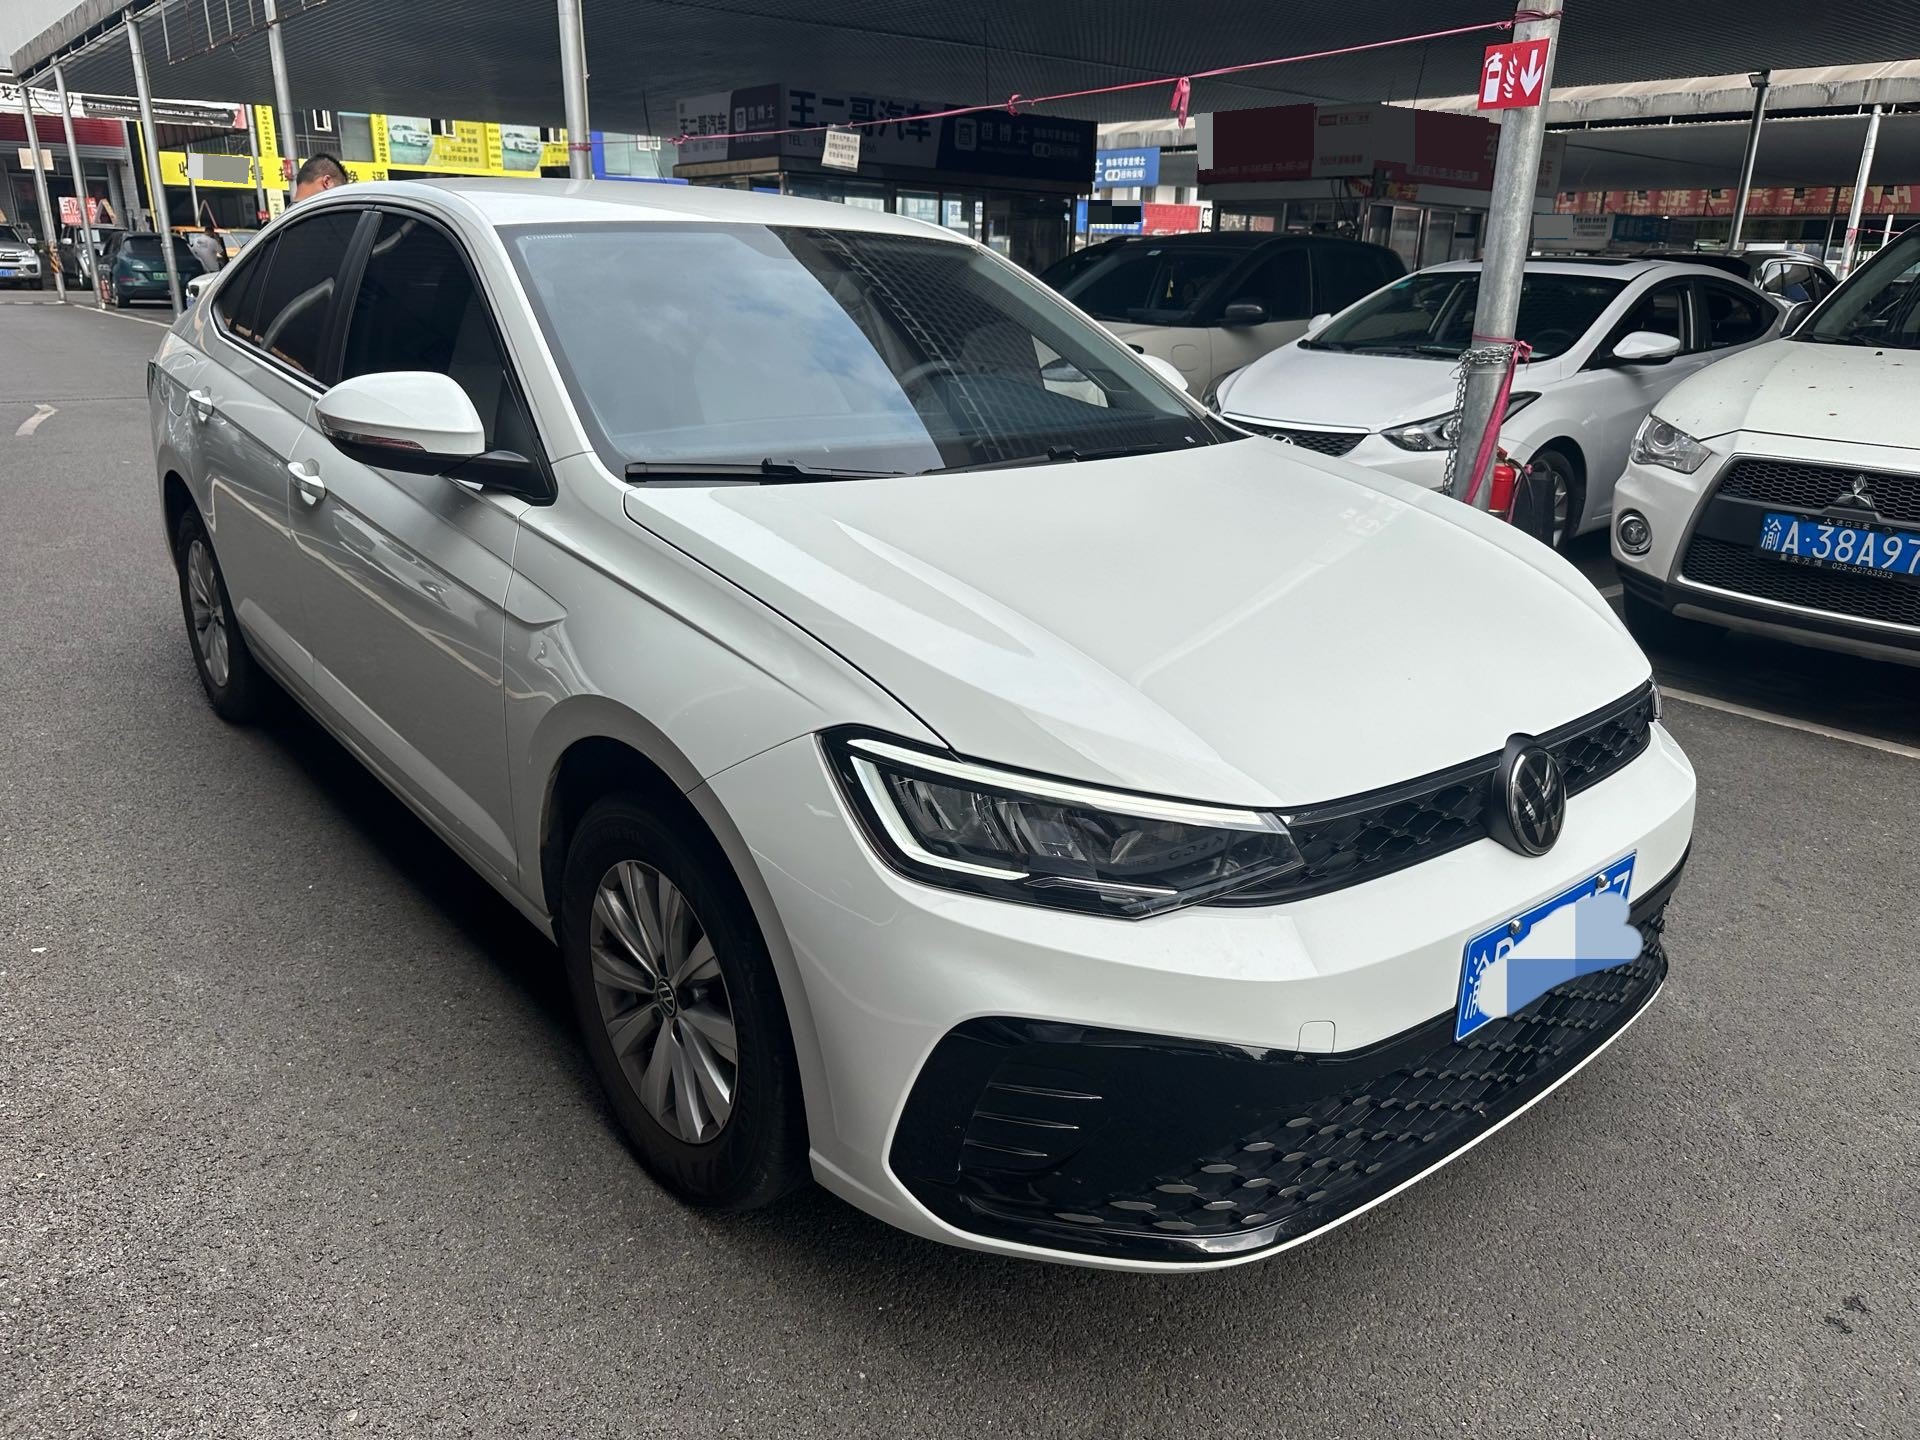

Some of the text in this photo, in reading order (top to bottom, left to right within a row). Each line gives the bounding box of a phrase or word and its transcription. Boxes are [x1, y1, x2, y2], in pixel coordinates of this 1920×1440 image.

[680, 112, 727, 135] 王二哥汽车
[789, 89, 932, 143] 王二哥汽车
